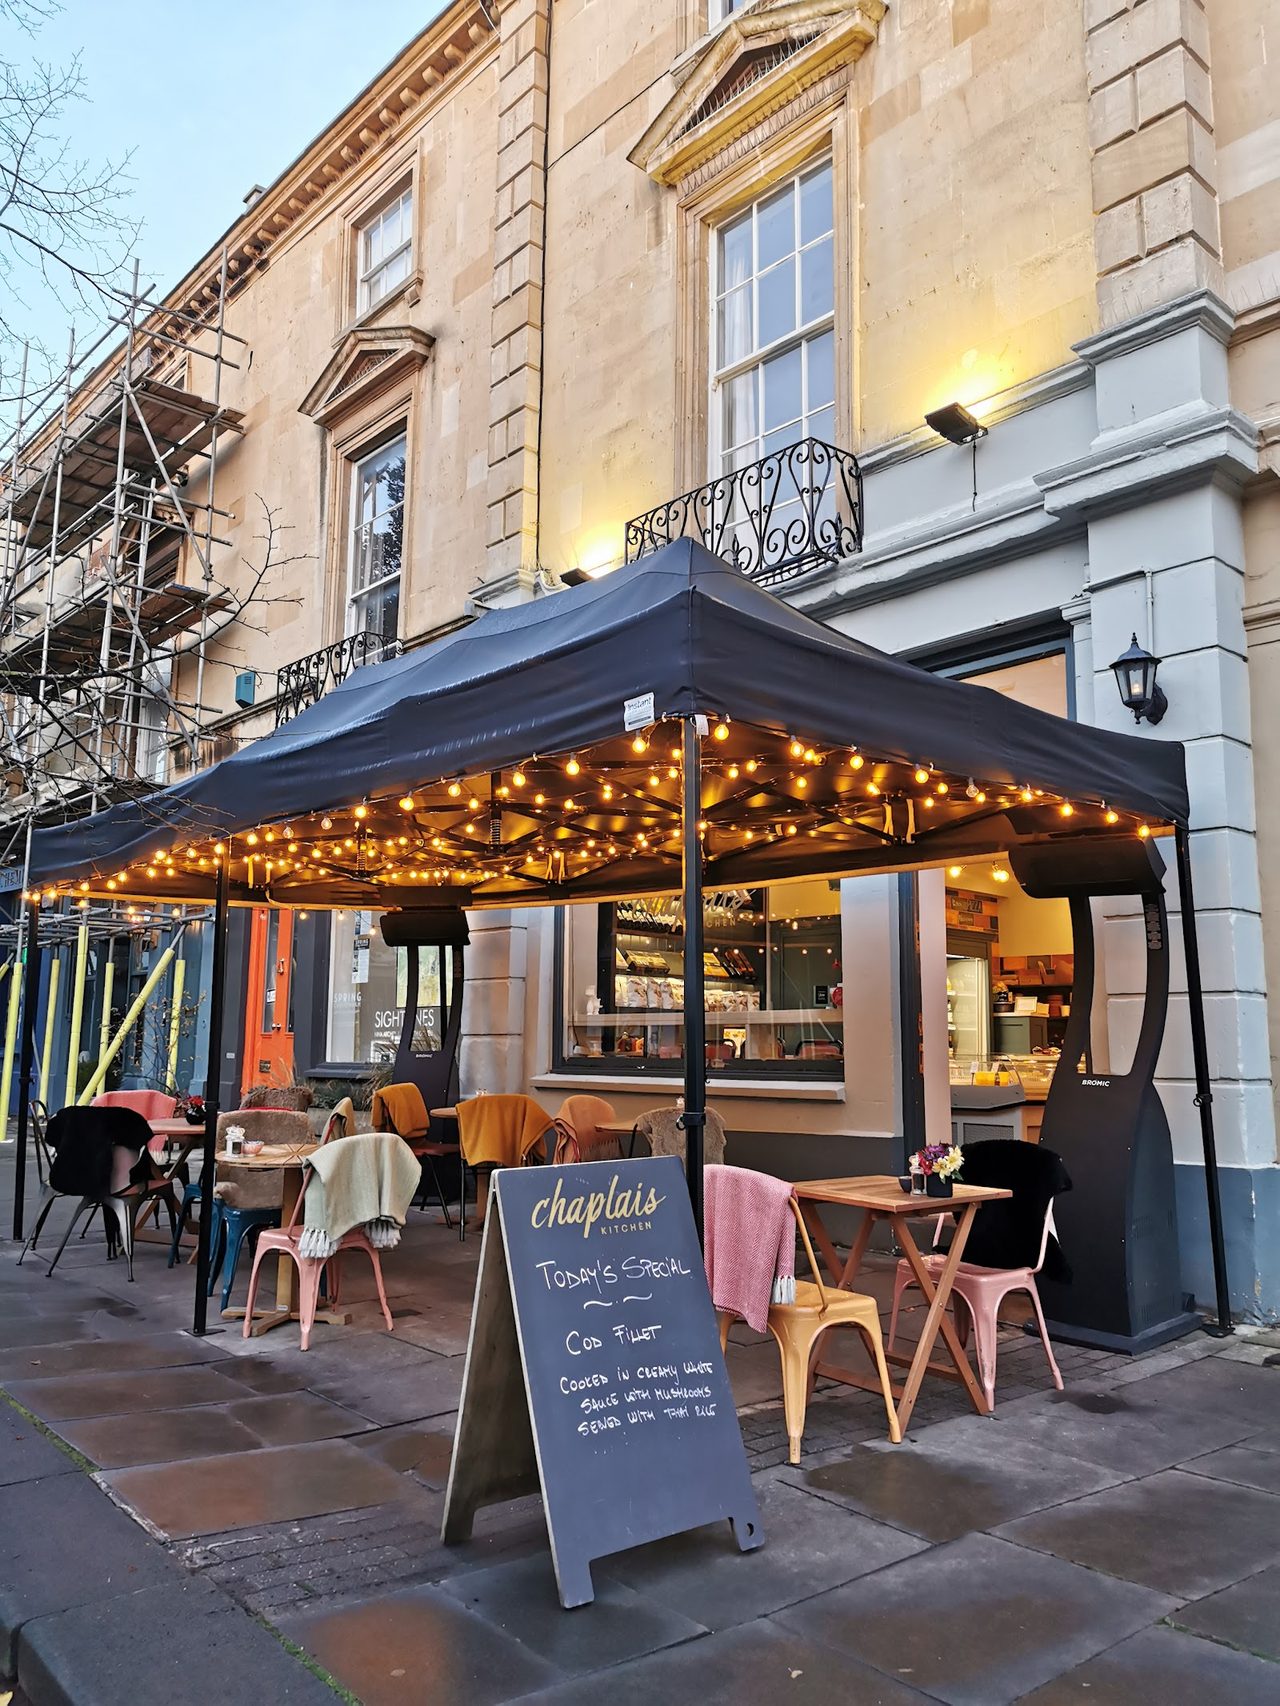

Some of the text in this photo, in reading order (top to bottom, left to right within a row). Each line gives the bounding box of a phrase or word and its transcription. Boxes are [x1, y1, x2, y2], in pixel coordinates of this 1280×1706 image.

[374, 1009, 435, 1028] SIGHTNES
[1081, 1079, 1111, 1087] BROMIC
[531, 1174, 667, 1239] chaplais
[600, 1221, 652, 1235] KITCHEN
